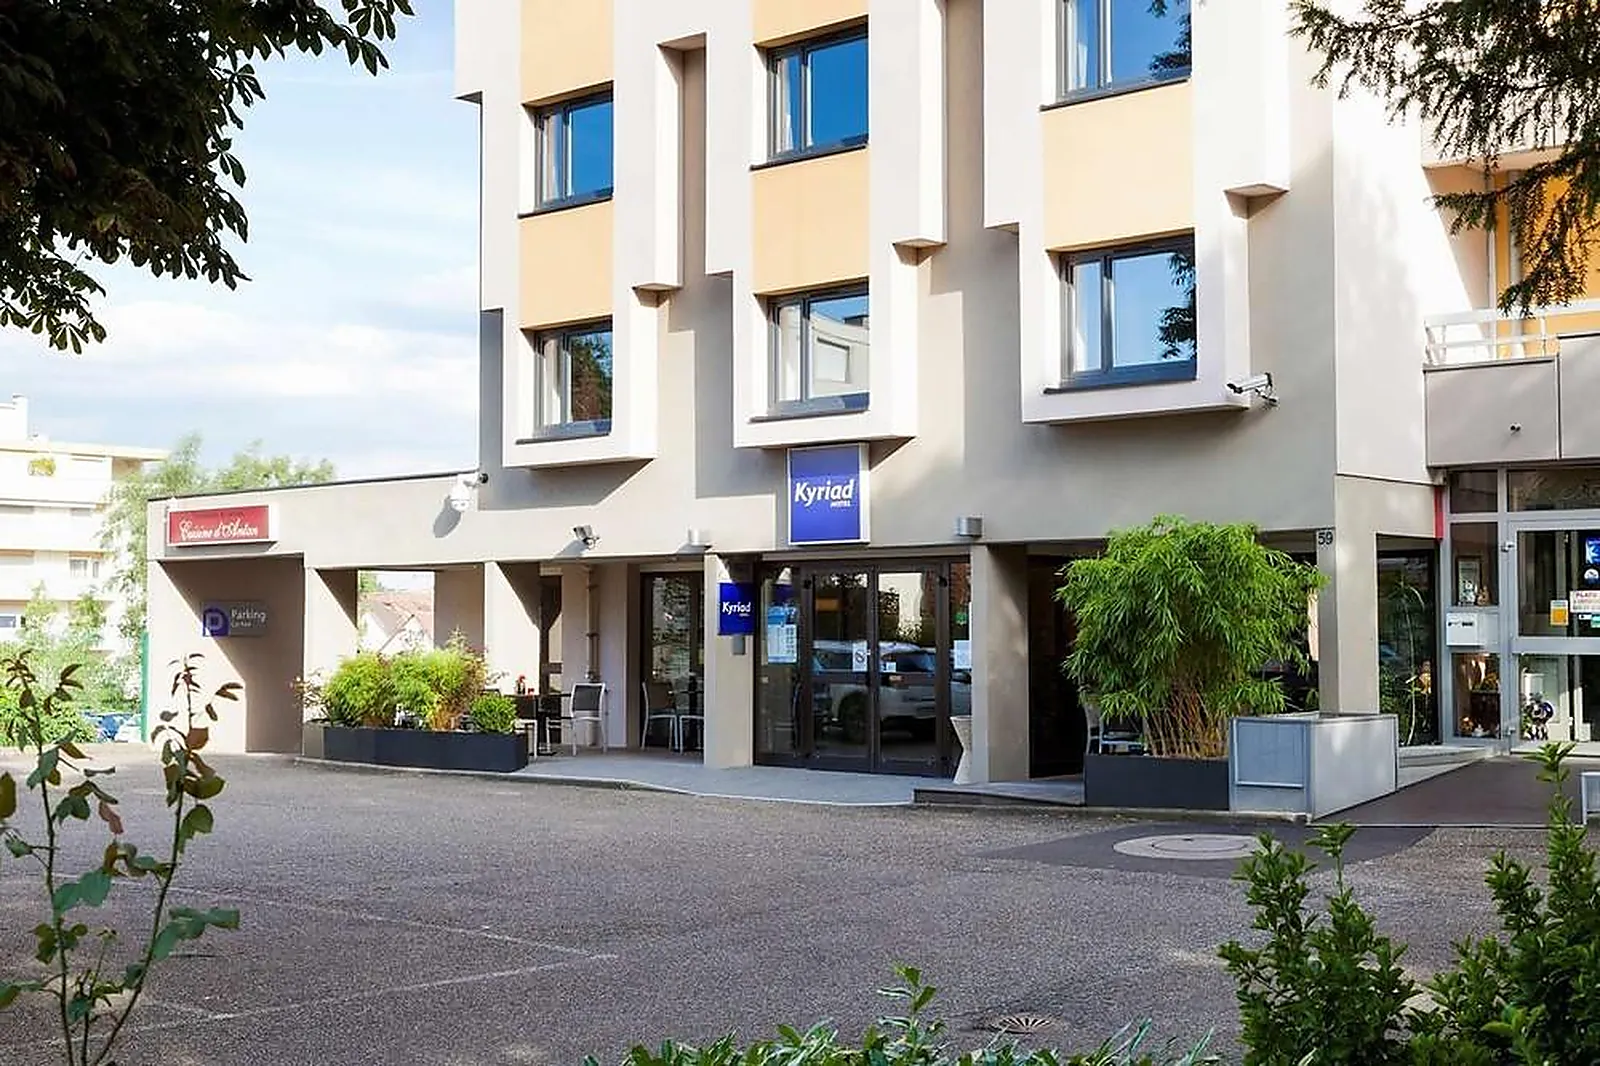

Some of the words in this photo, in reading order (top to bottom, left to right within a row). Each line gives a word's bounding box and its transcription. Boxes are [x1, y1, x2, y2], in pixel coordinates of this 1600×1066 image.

[794, 478, 854, 507] Kyriad
[1318, 531, 1333, 545] 59
[231, 608, 266, 623] Parking
[722, 601, 752, 616] Kyriad
